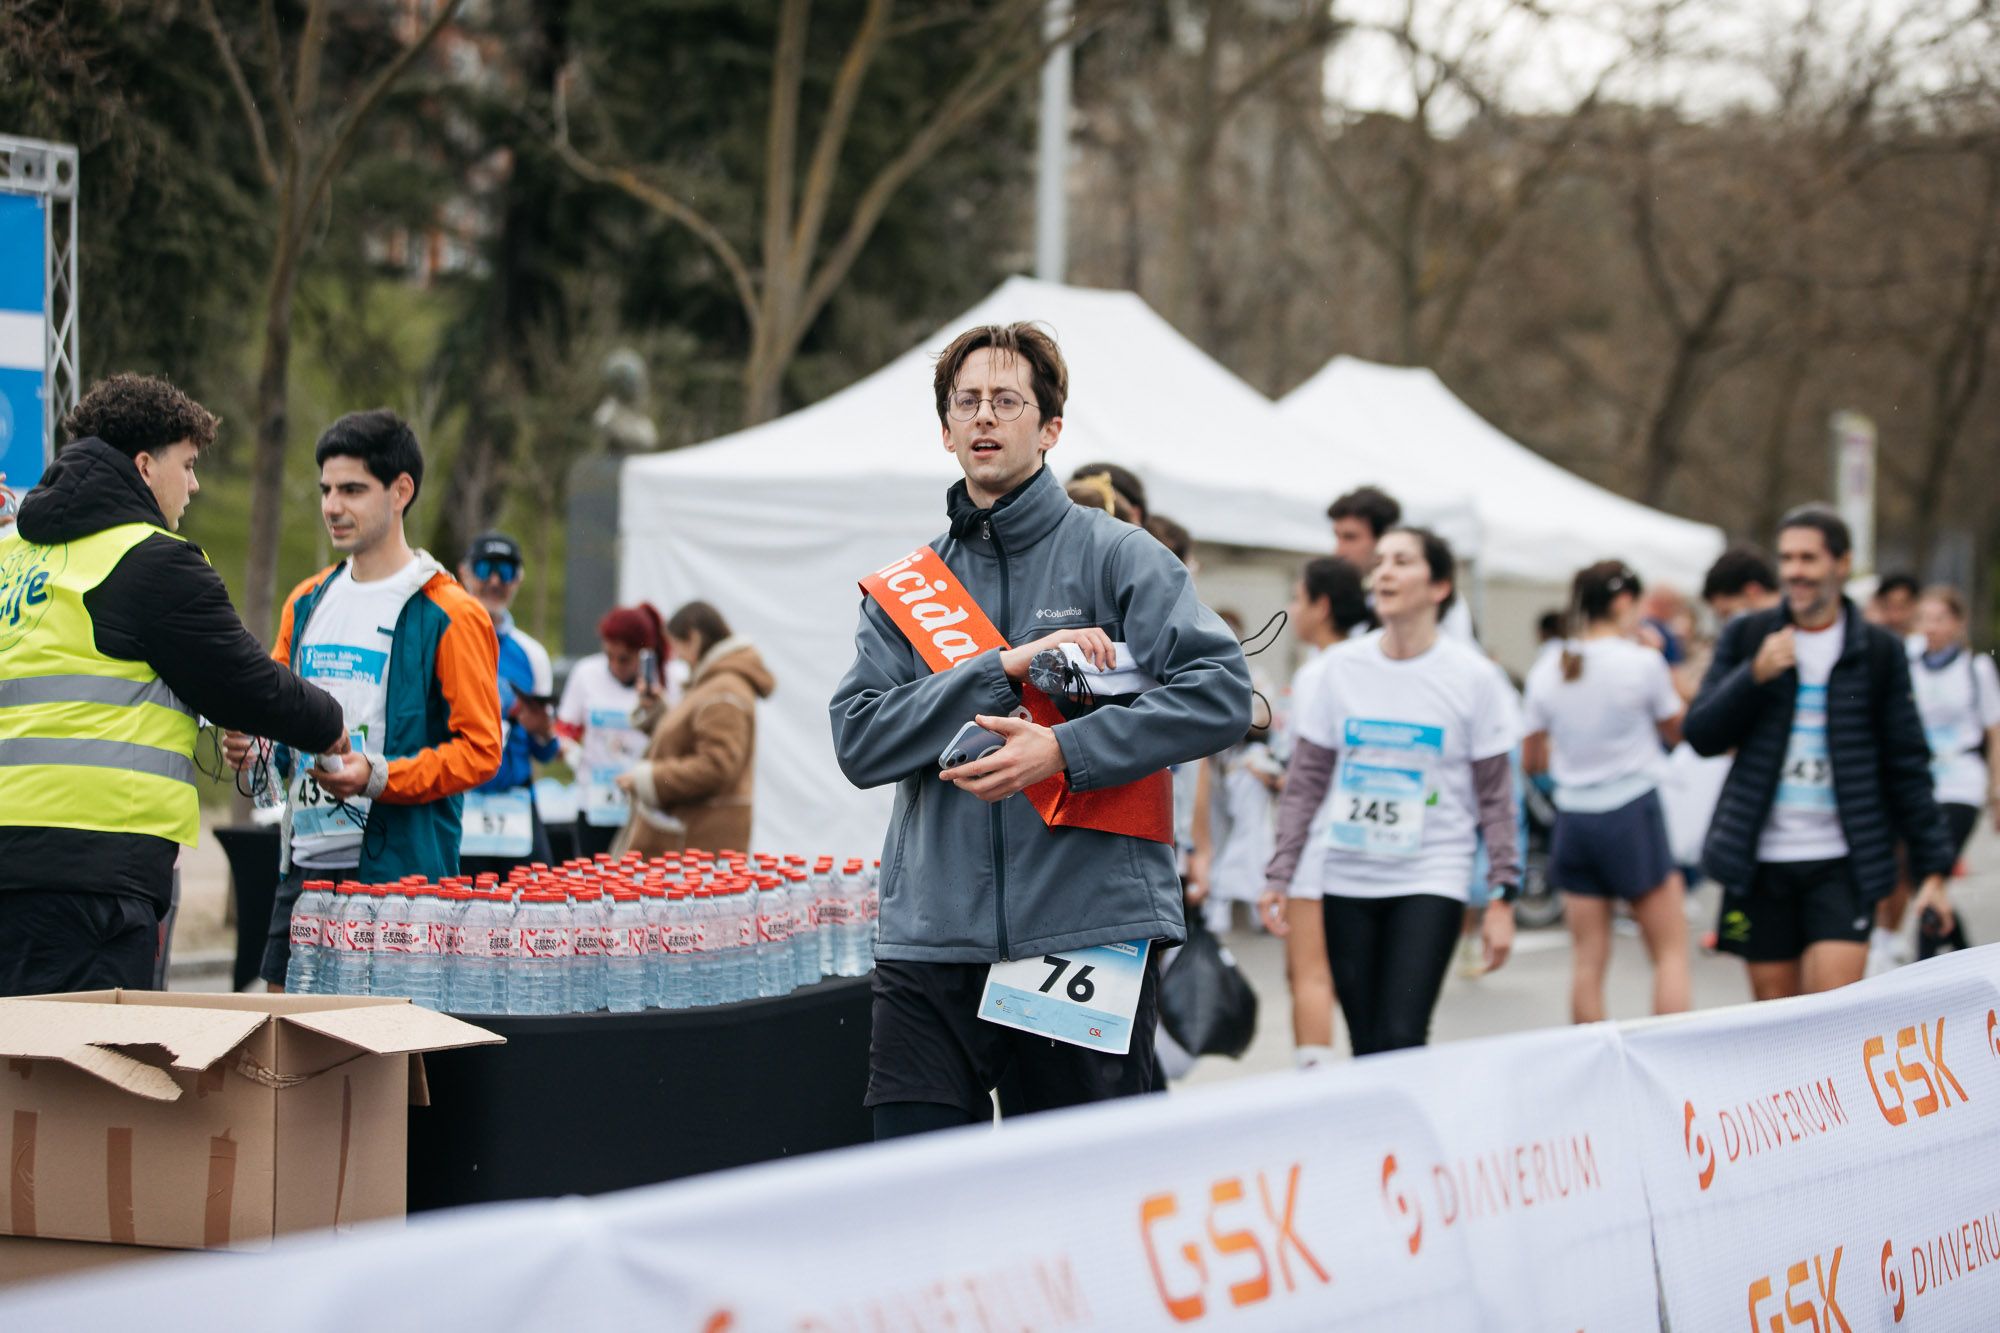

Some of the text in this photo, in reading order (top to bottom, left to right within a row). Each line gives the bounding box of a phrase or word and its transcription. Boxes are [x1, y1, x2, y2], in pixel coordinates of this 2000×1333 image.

[1044, 606, 1082, 618] Columbia
[1349, 798, 1399, 826] 245
[1038, 954, 1096, 1003] 76
[1718, 1016, 1970, 1162] DIAVERUM GSK
[1139, 1163, 1332, 1323] GSK
[1431, 1133, 1602, 1227] DIAVERUM
